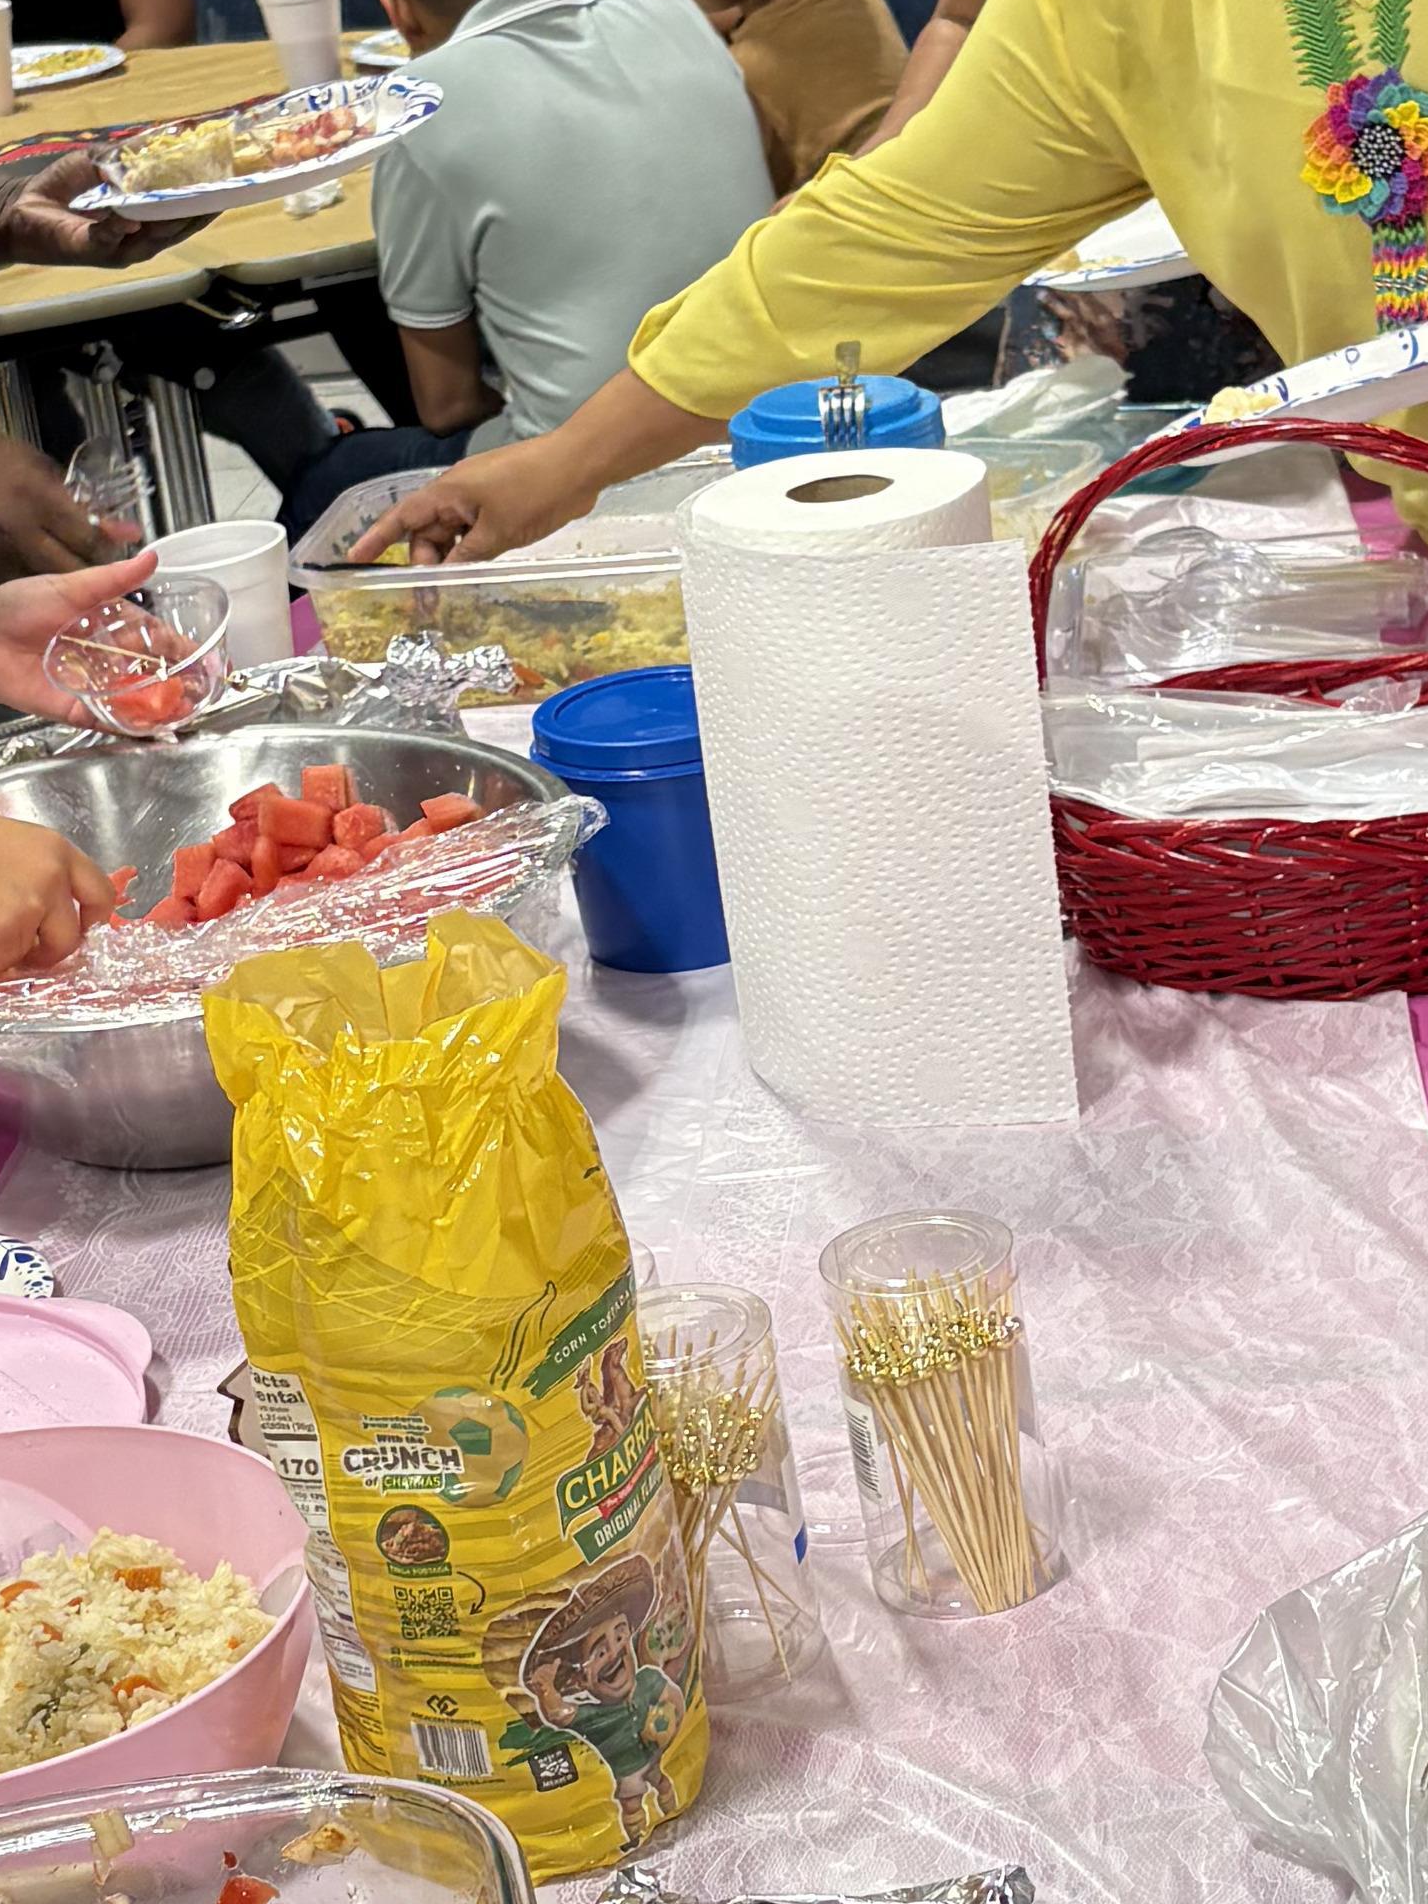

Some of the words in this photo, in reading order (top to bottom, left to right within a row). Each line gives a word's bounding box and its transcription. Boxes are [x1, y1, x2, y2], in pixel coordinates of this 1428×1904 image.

[554, 1332, 588, 1364] CORN
[253, 1371, 291, 1388] acts
[255, 1390, 306, 1404] ental
[279, 1457, 319, 1476] 170
[343, 1446, 462, 1473] CRUNCH
[564, 1407, 657, 1510] CHARRA
[365, 1476, 378, 1487] of
[594, 1497, 642, 1548] ORIGINAL
